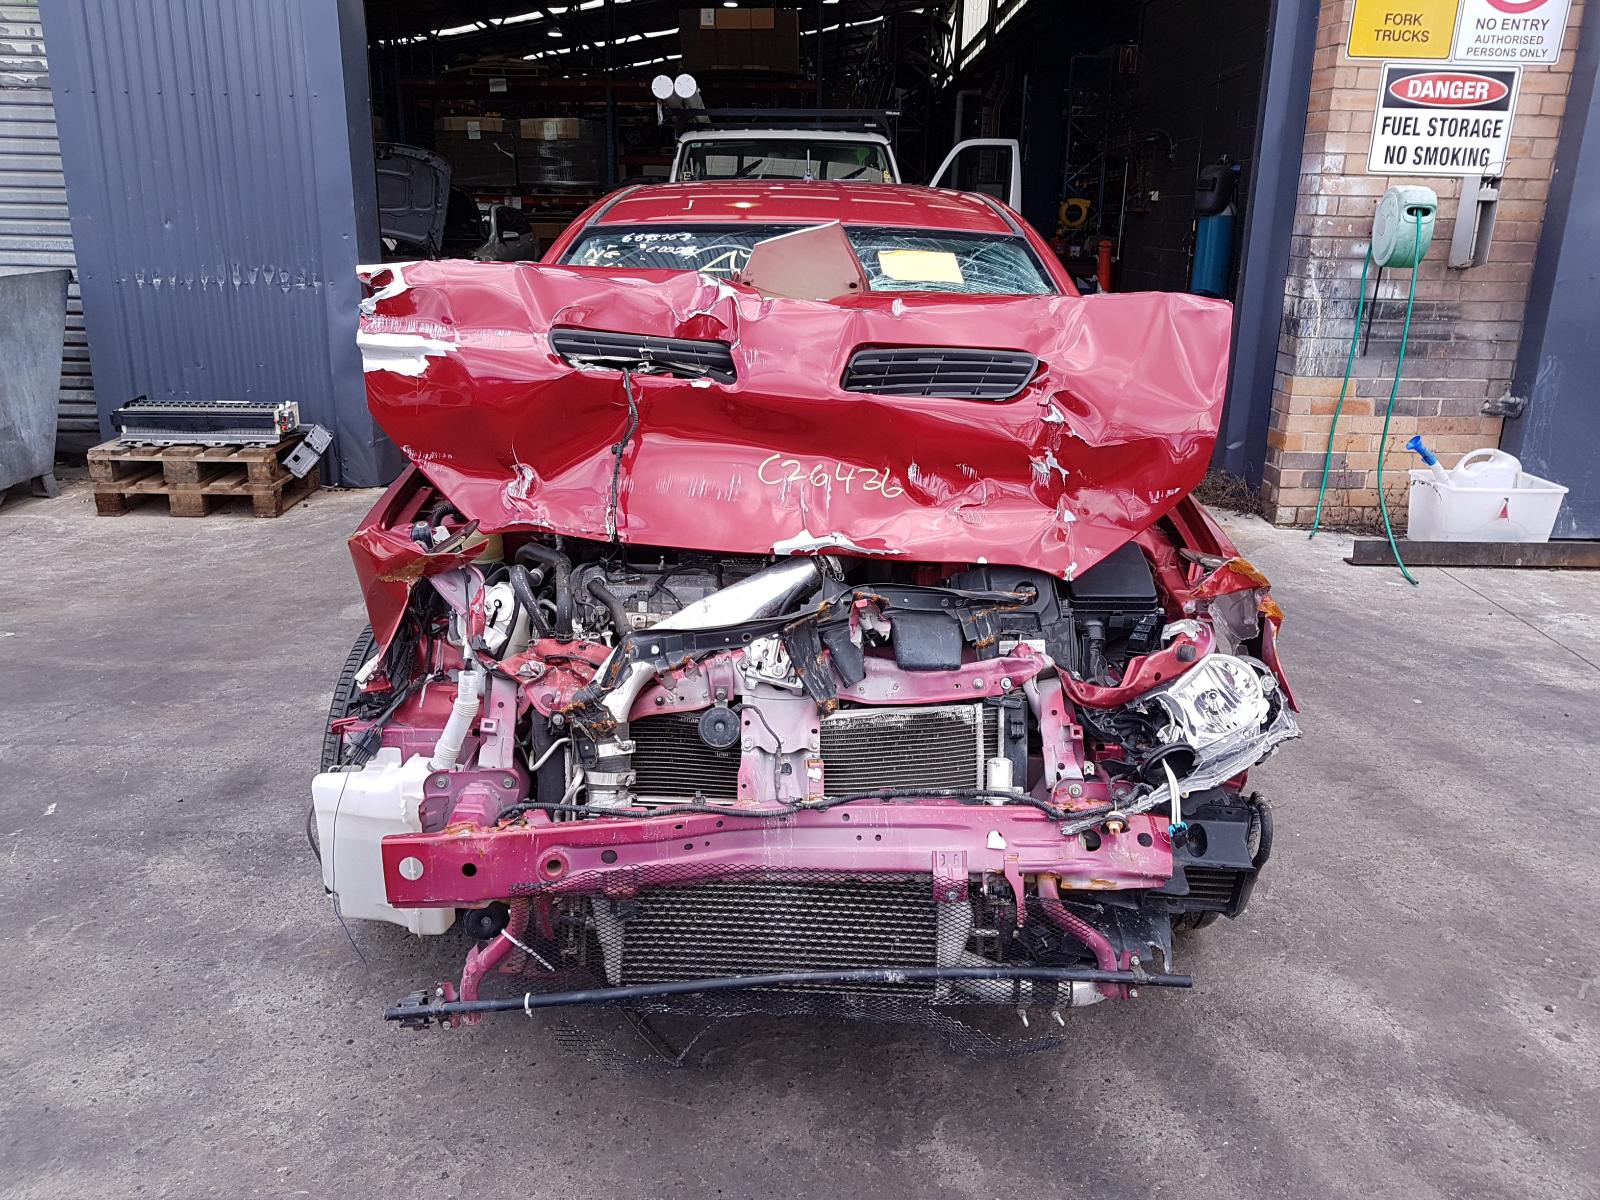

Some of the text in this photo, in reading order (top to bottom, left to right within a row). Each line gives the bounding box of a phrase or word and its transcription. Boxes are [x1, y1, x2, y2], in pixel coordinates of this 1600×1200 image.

[1384, 13, 1423, 26] FORK
[1475, 18, 1550, 31] NO ENTRY
[1374, 29, 1430, 43] TRUCKS
[1475, 34, 1544, 45] AUTHORISED
[1466, 47, 1548, 58] PERSONS ONLY
[1407, 79, 1489, 100] DANGER
[1381, 116, 1503, 138] FUEL STORAGE
[1384, 145, 1490, 167] NO SMOKING
